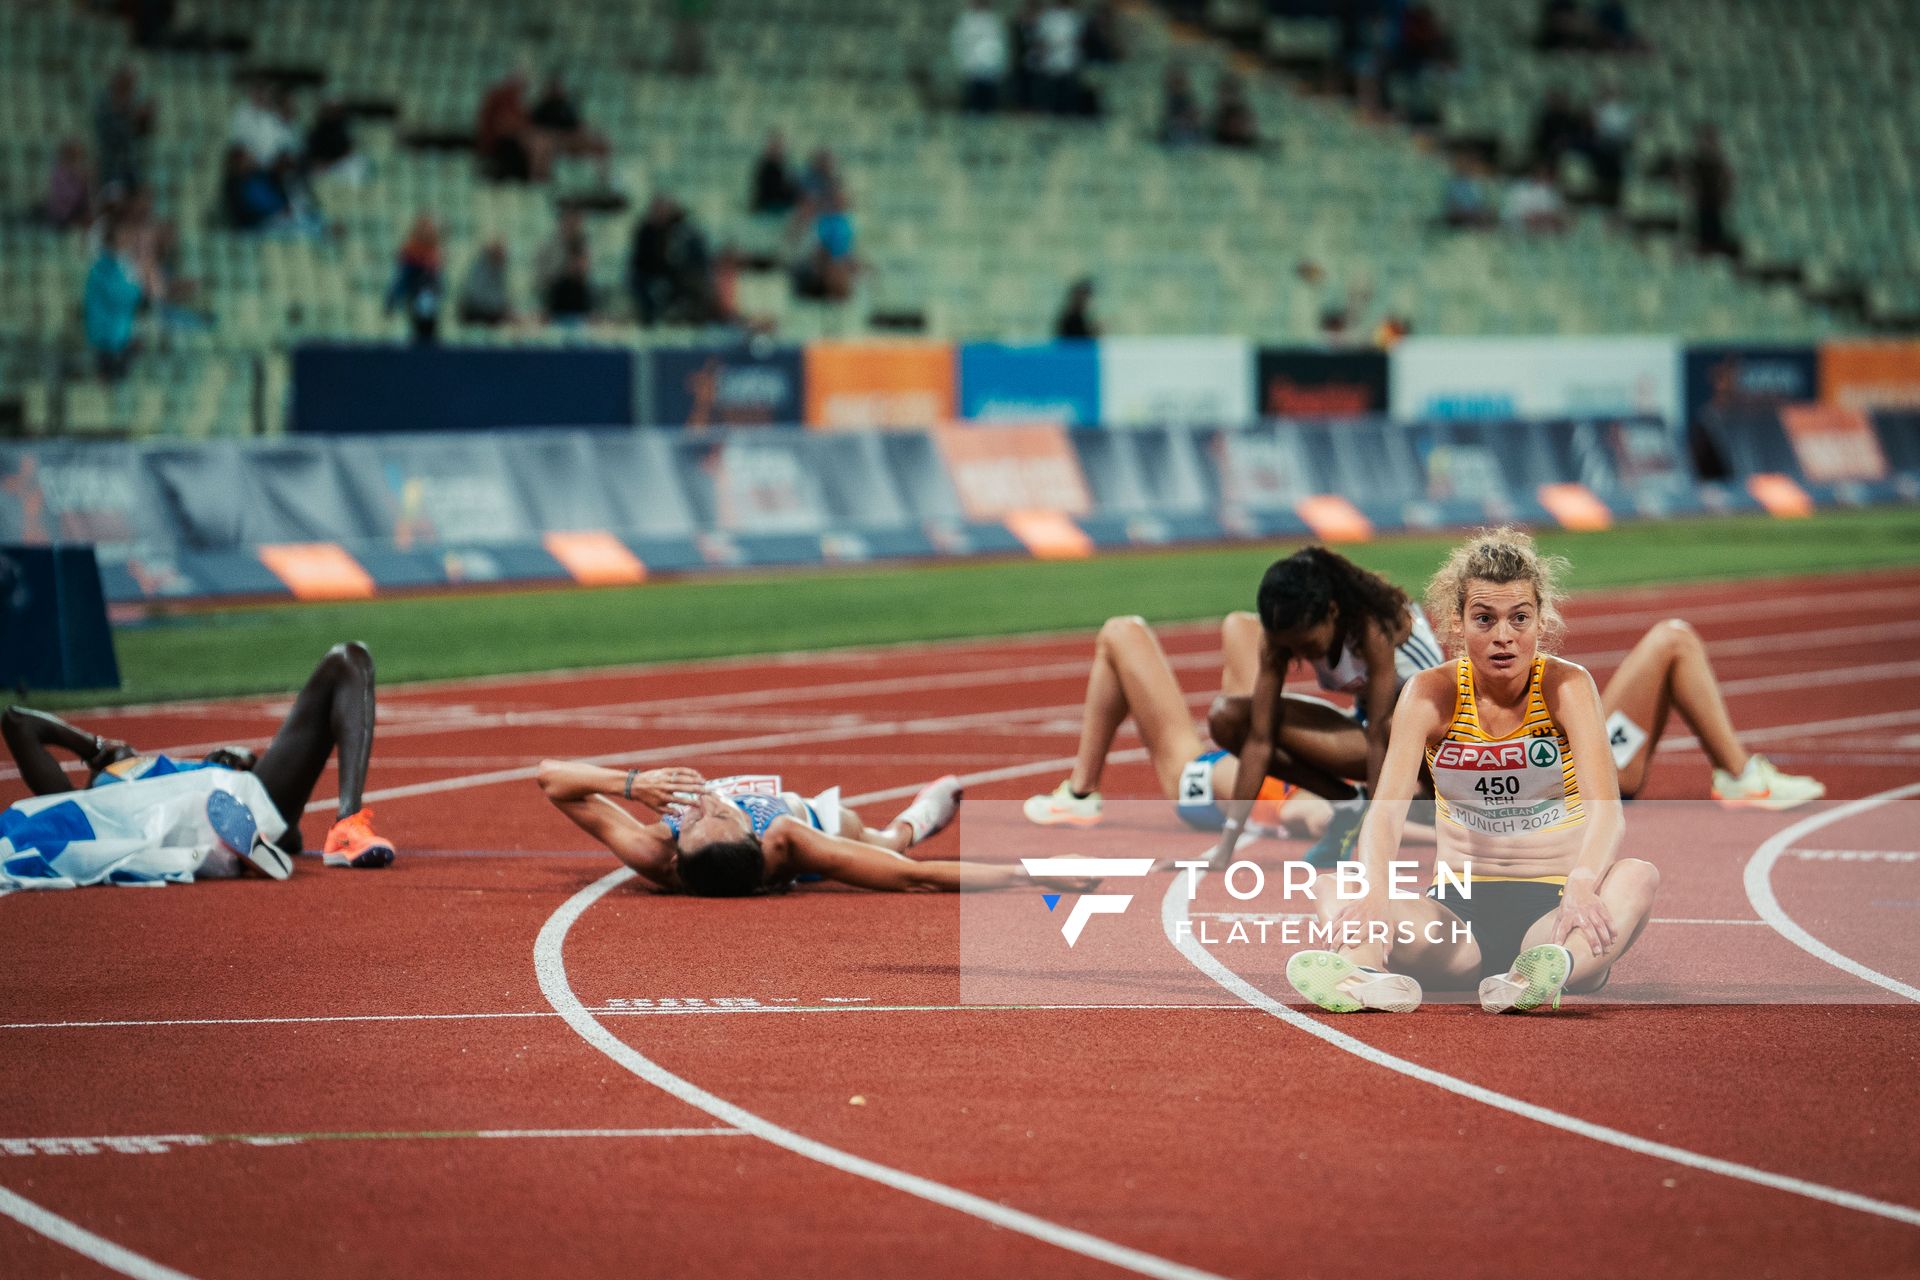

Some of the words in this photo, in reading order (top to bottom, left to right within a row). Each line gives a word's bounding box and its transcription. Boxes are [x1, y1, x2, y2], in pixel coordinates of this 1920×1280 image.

[1439, 746, 1524, 768] SPAR
[1474, 775, 1520, 796] 450
[1484, 796, 1515, 807] REH
[1455, 807, 1515, 833] MUNICH
[1520, 808, 1560, 831] 2022
[1500, 807, 1535, 818] CLEAN
